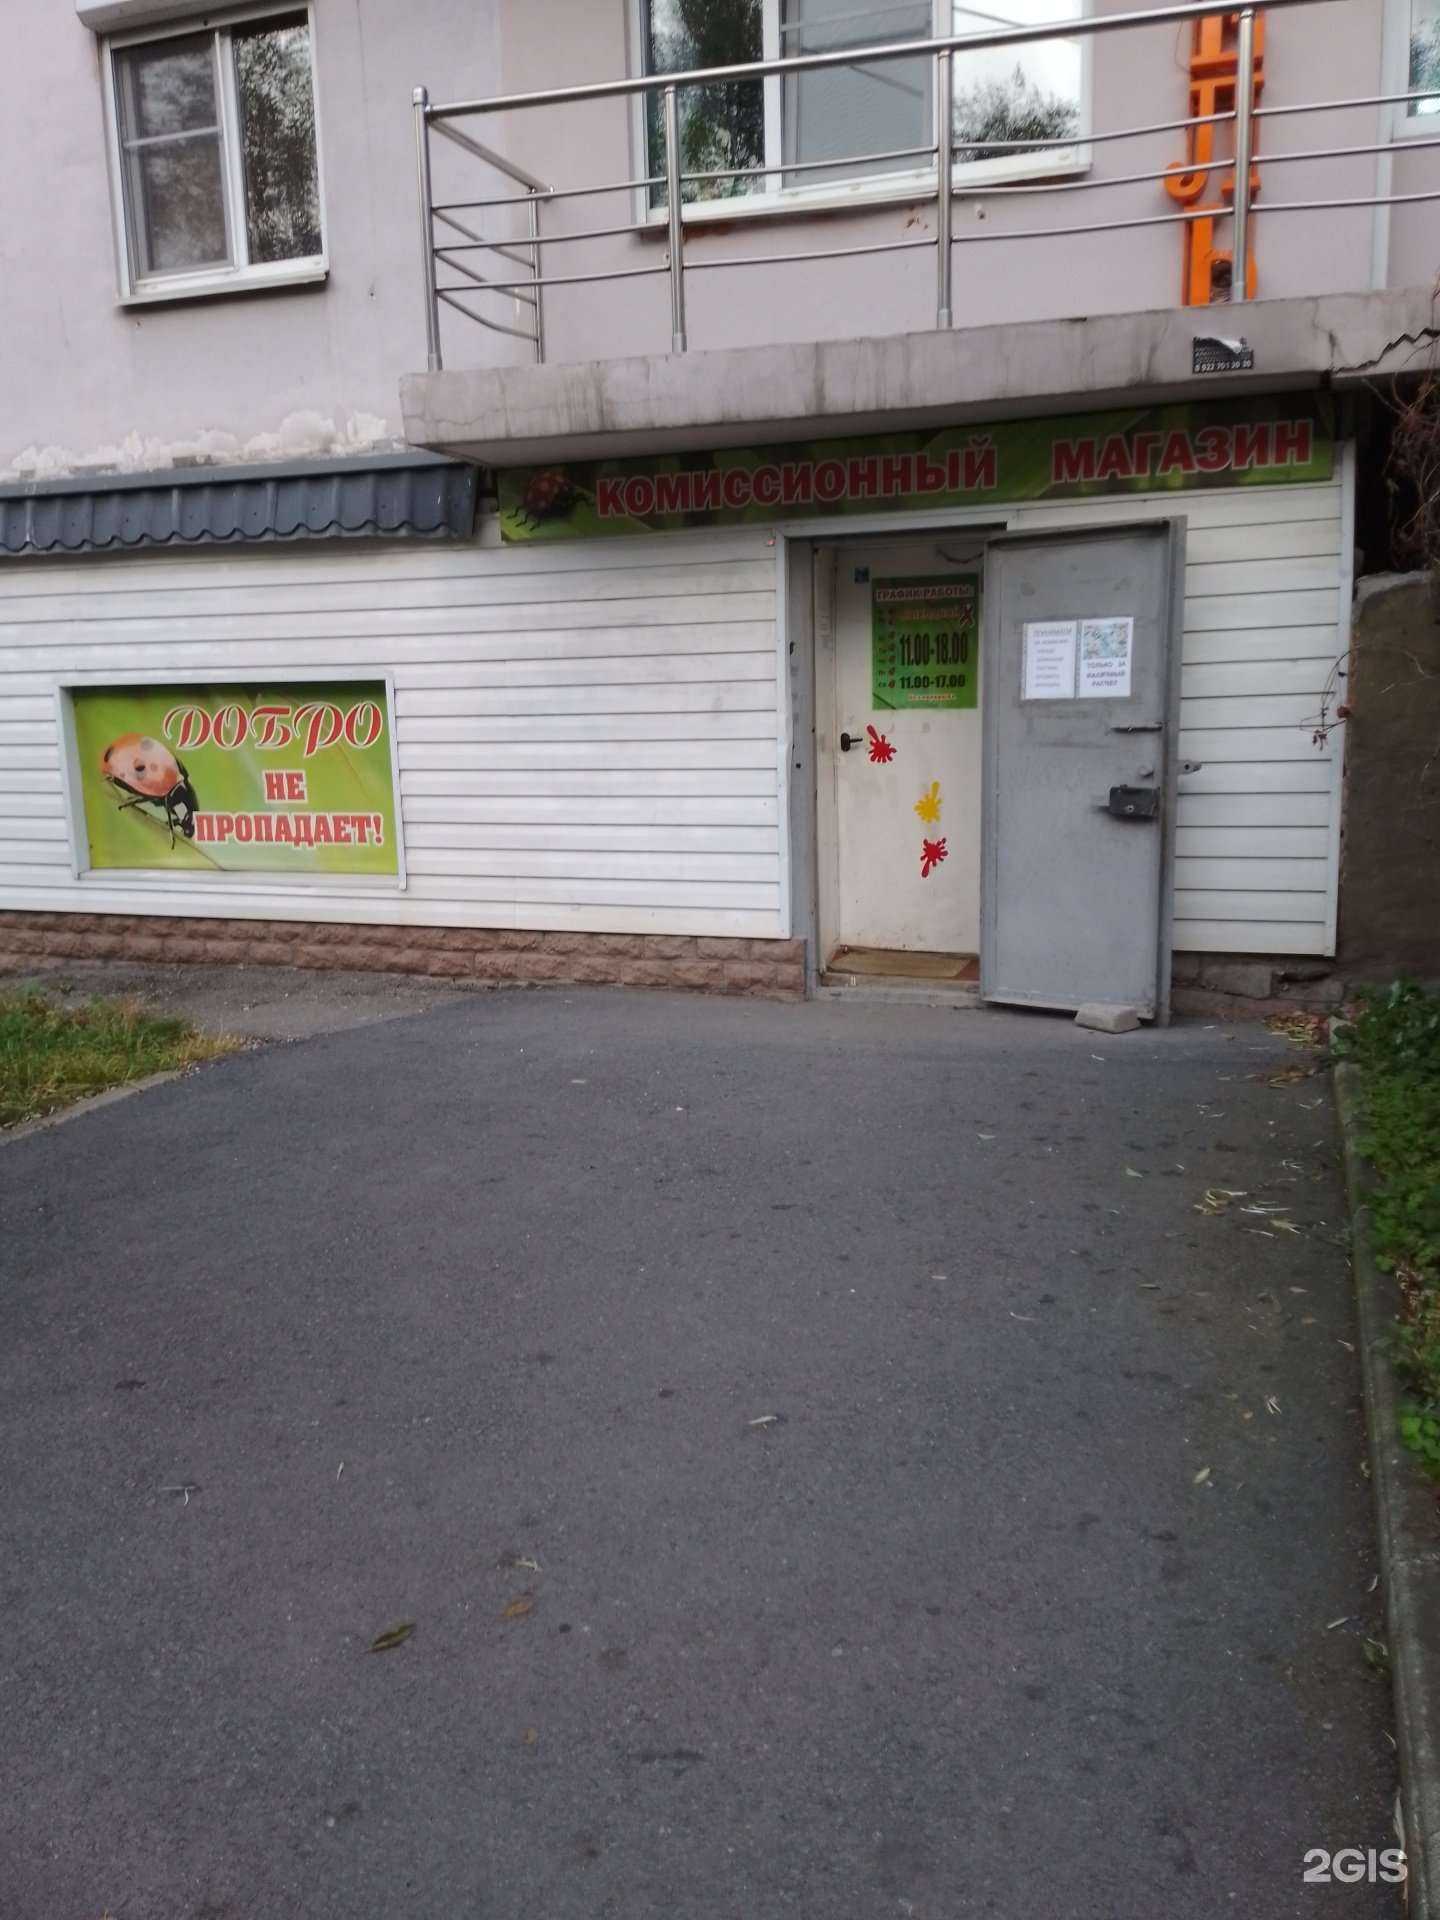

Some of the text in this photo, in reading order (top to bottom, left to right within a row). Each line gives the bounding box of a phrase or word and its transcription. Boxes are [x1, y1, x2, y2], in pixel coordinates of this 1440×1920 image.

[596, 419, 1314, 518] КОМИССИОННЫЙ МАГАЗИН
[163, 700, 384, 759] ДОБРО
[263, 769, 308, 803] НЕ
[193, 811, 385, 847] ПРОПАДАЕТ!
